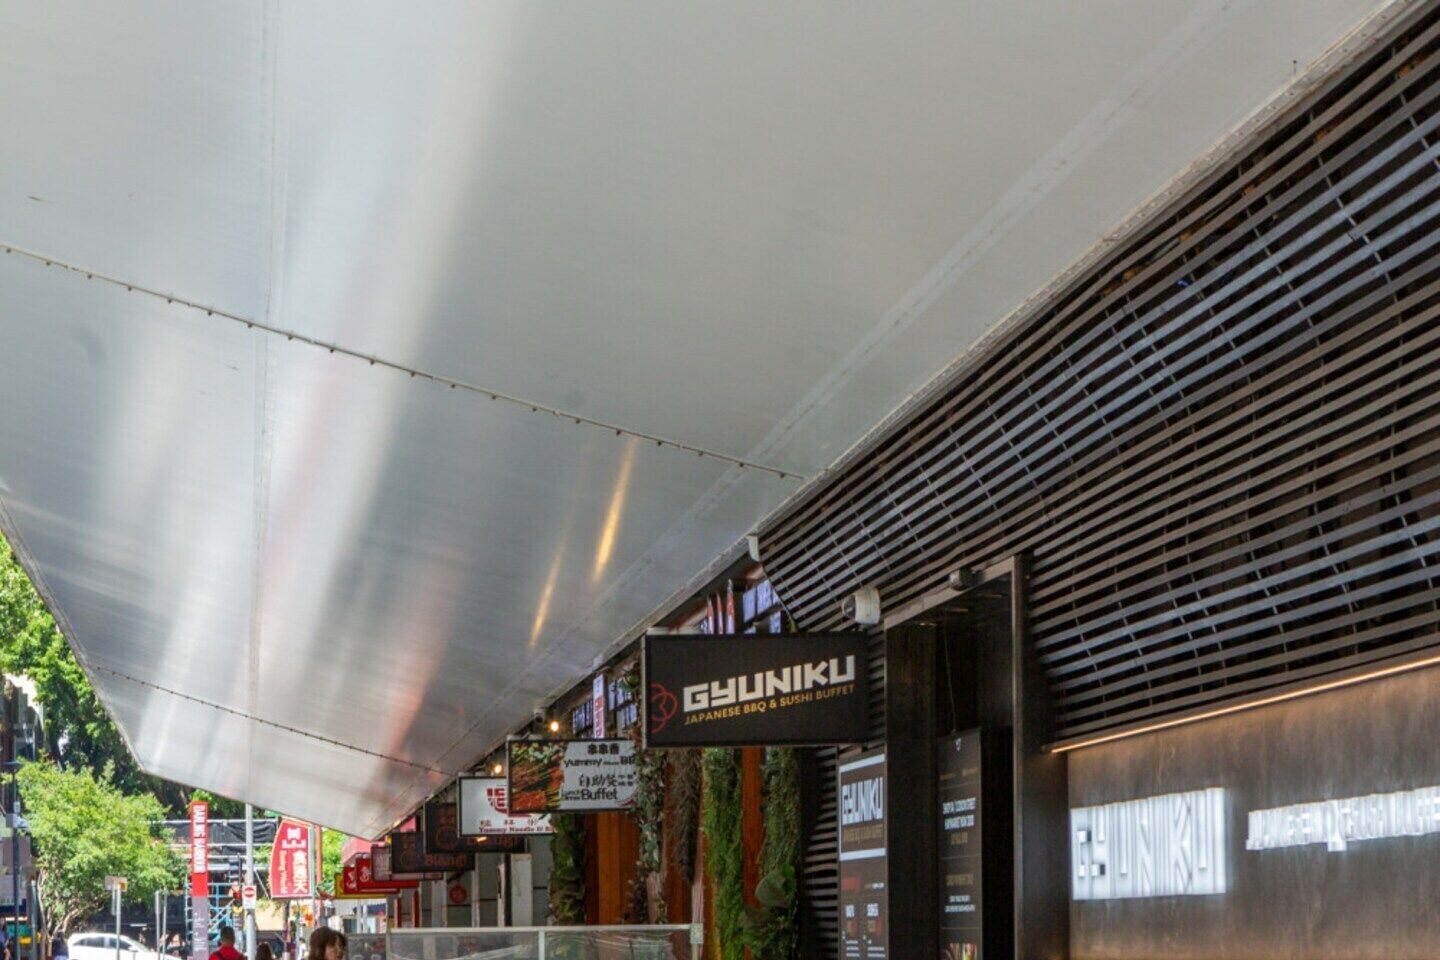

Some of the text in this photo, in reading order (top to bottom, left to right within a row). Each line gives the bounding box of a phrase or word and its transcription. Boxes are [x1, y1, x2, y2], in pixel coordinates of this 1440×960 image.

[683, 655, 856, 713] GYUNIKU
[685, 683, 856, 726] JAPANESE BBQ & SUSHI BUFFET
[581, 788, 618, 801] Buffet
